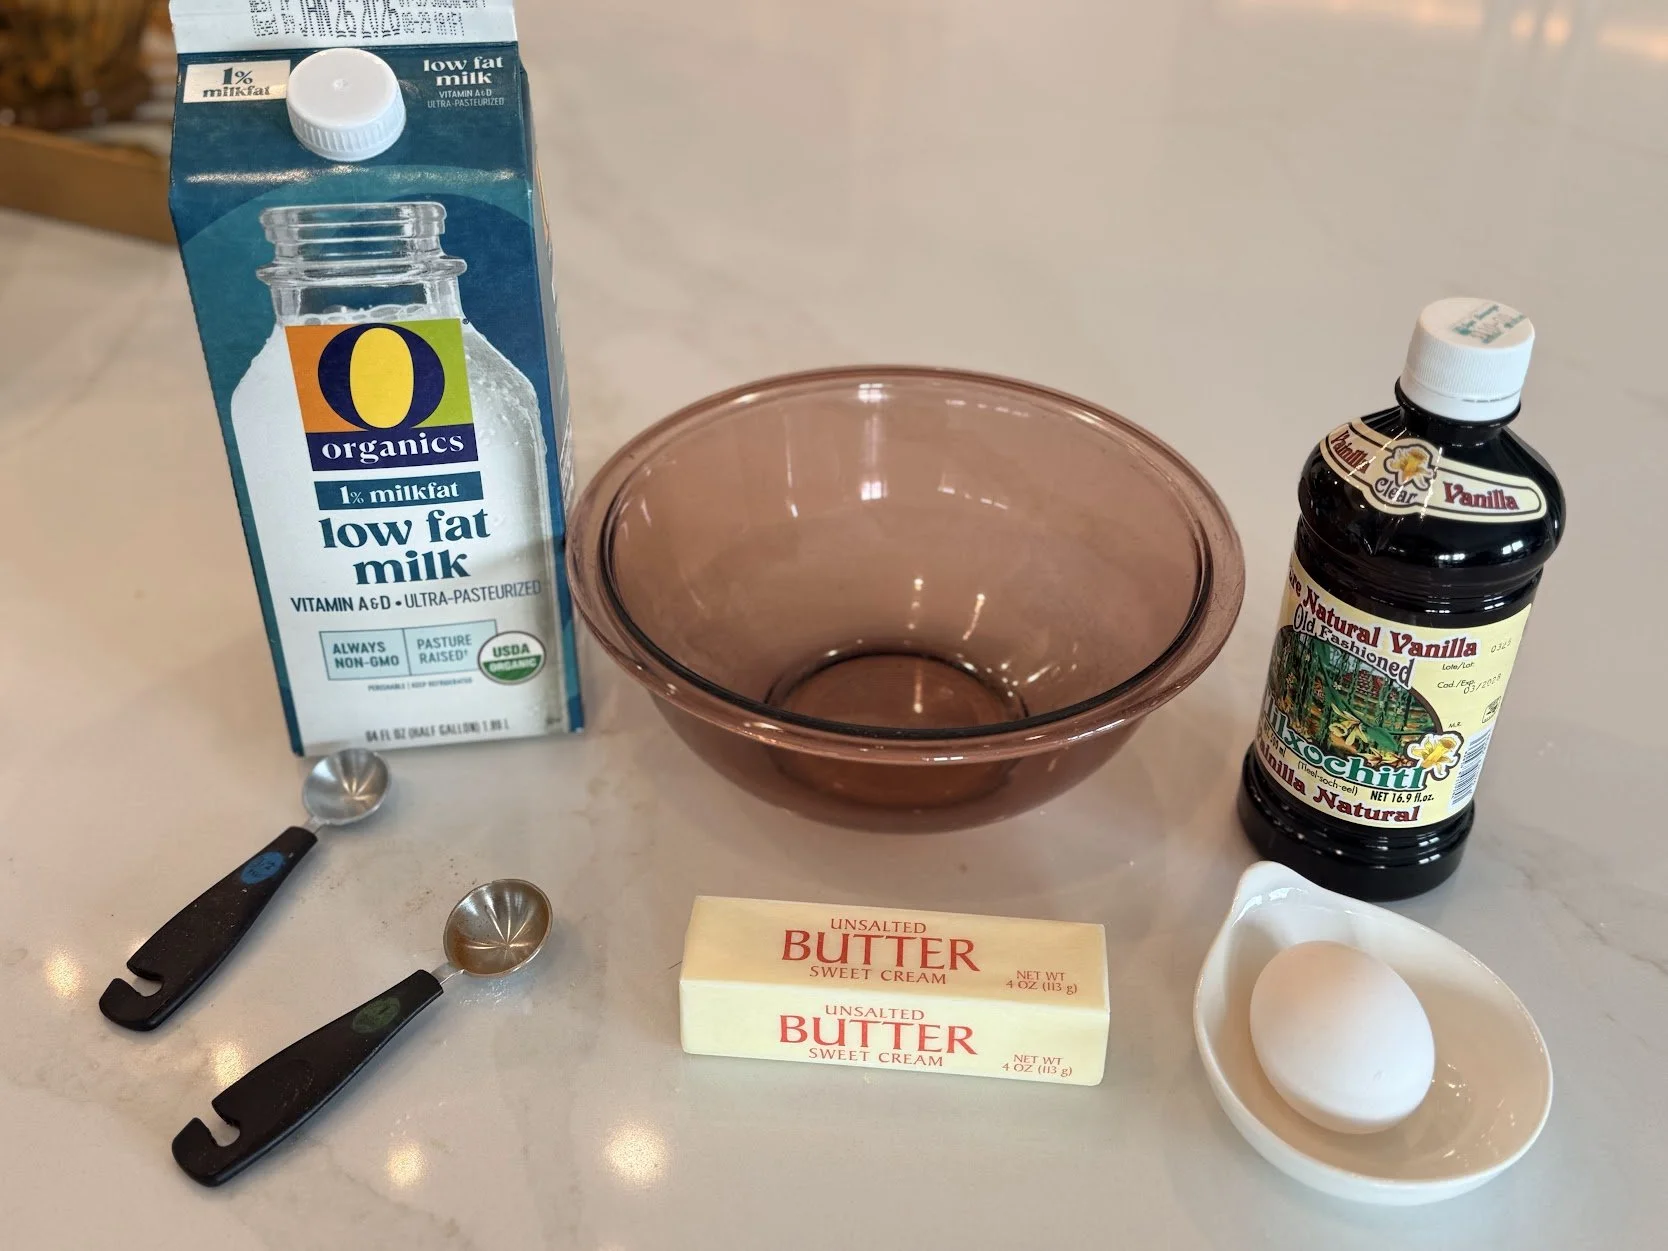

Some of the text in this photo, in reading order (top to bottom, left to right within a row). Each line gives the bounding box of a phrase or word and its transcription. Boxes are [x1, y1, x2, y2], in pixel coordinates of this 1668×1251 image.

[424, 56, 504, 71] low fat
[222, 67, 253, 85] 1%
[436, 72, 492, 86] milk
[203, 85, 270, 98] milkfat
[439, 90, 473, 98] VITAMIN
[427, 97, 504, 108] ULTRA-PASTEURIZED
[318, 322, 446, 431] O
[322, 432, 465, 464] organics
[340, 481, 460, 505] 1% milkfat
[1375, 477, 1418, 504] Clear
[1442, 481, 1520, 510] Vanilla
[318, 508, 491, 549] low fat
[353, 549, 471, 585] milk
[290, 597, 354, 612] VITAMIN
[404, 580, 542, 609] ULTRA-PASTEURIZED
[1303, 585, 1381, 648] Natural
[1390, 630, 1477, 659] Vanilla
[333, 641, 386, 655] ALWAYS
[417, 634, 472, 650] PASTURE
[493, 643, 530, 657] USDA
[1293, 603, 1415, 687] Old Fashioned
[335, 655, 399, 669] NON-GMO
[489, 657, 537, 673] ORGANIC
[380, 728, 391, 741] FL
[1259, 740, 1420, 822] ainilla Natural
[1370, 791, 1389, 803] NET
[1391, 792, 1412, 803] 16.9
[830, 918, 927, 934] UNSALTED
[781, 929, 980, 972] BUTTER
[809, 965, 947, 984] SWEET CREAM
[1016, 970, 1067, 982] NET WT
[1006, 980, 1078, 995] 4 OZ (113 g)
[825, 1004, 925, 1020] UNSALTED
[778, 1015, 978, 1055] BUTTER
[808, 1047, 943, 1067] SWEET CREAM
[1013, 1054, 1063, 1065] NET WT
[1002, 1062, 1073, 1077] 4 OZ (113 g)
